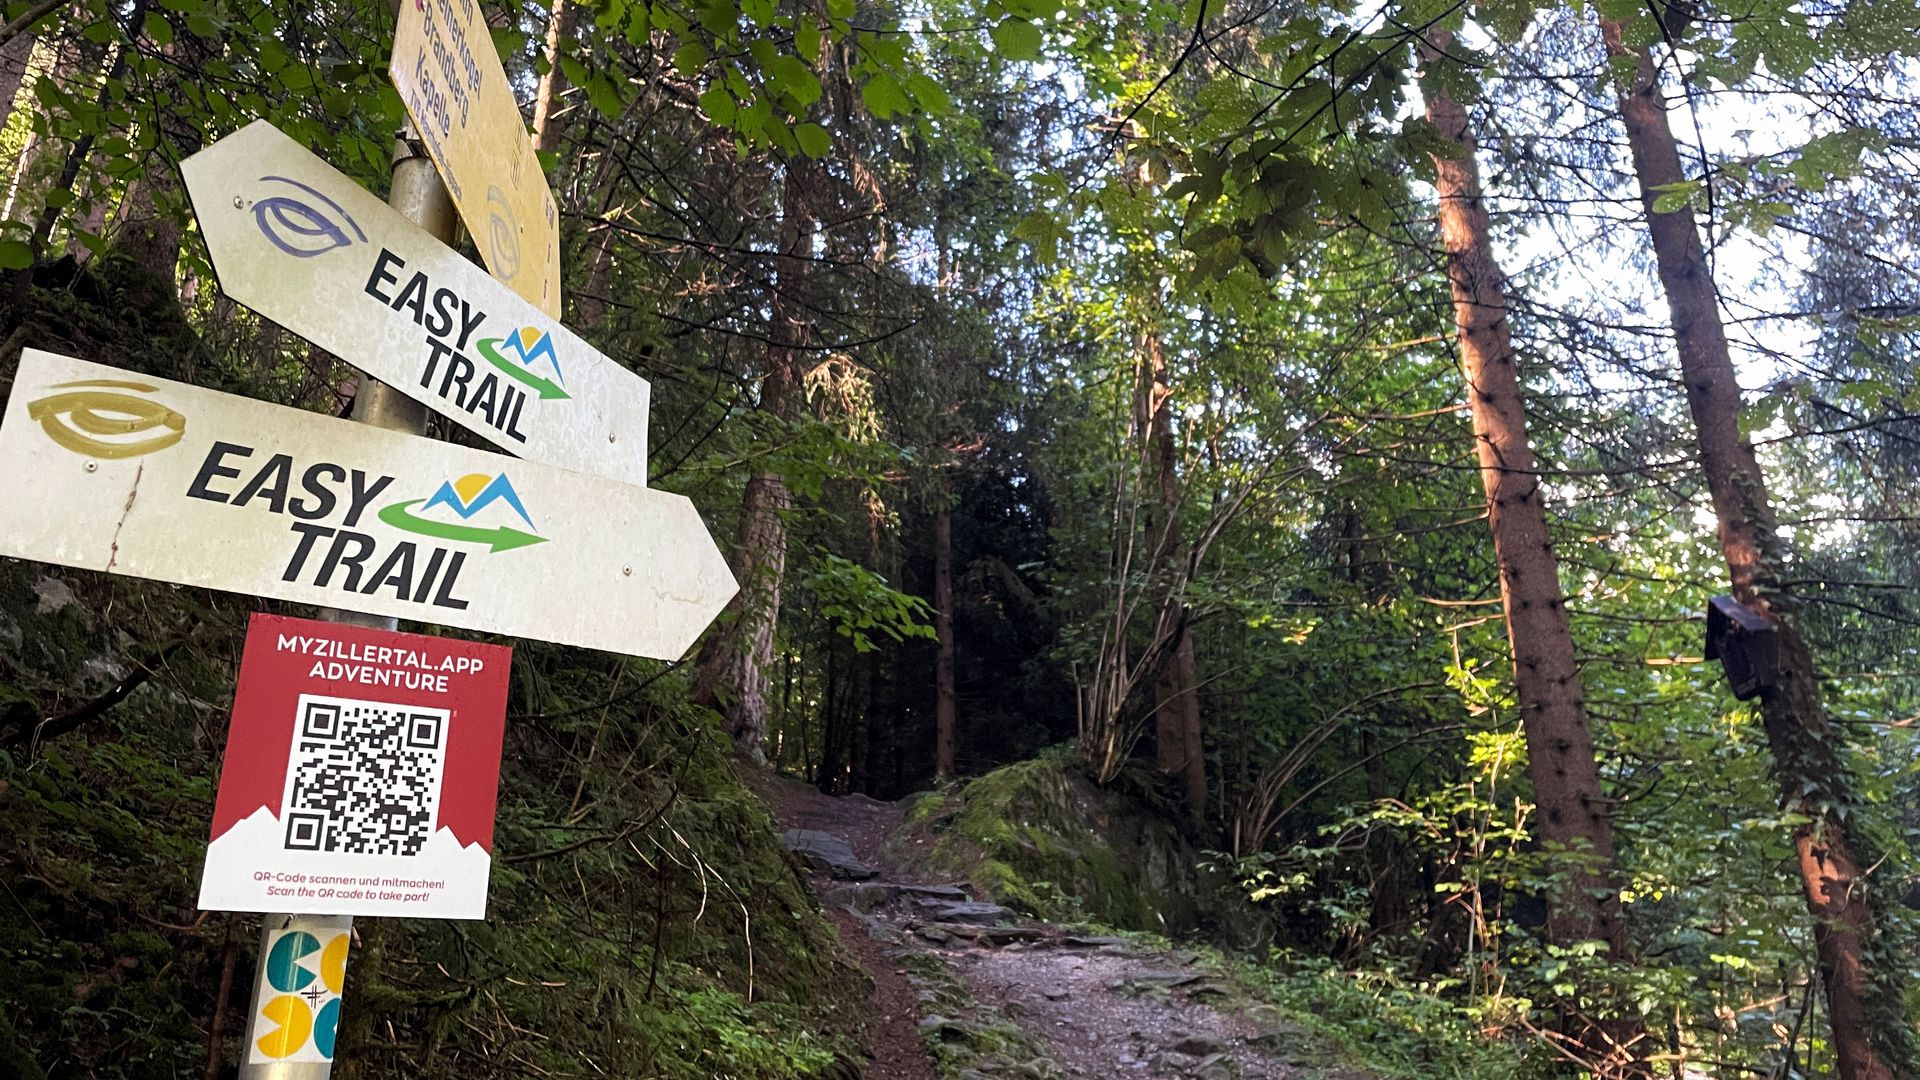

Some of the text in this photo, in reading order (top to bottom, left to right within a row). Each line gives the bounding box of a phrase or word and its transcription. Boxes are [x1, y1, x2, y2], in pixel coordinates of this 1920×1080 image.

[415, 46, 450, 137] Kapelle
[424, 0, 469, 128] Brandberg
[437, 0, 482, 100] einerkogel
[364, 247, 487, 351] EASY
[420, 335, 527, 444] TRAIL
[186, 441, 396, 527] EASY
[281, 522, 470, 610] TRAIL
[277, 633, 484, 675] MYZILLERTAL.APP
[309, 660, 449, 693] ADVENTURE
[253, 871, 445, 889] QR-Code scannen und mitmachen!
[267, 885, 430, 903] Scan the QR code to take part!
